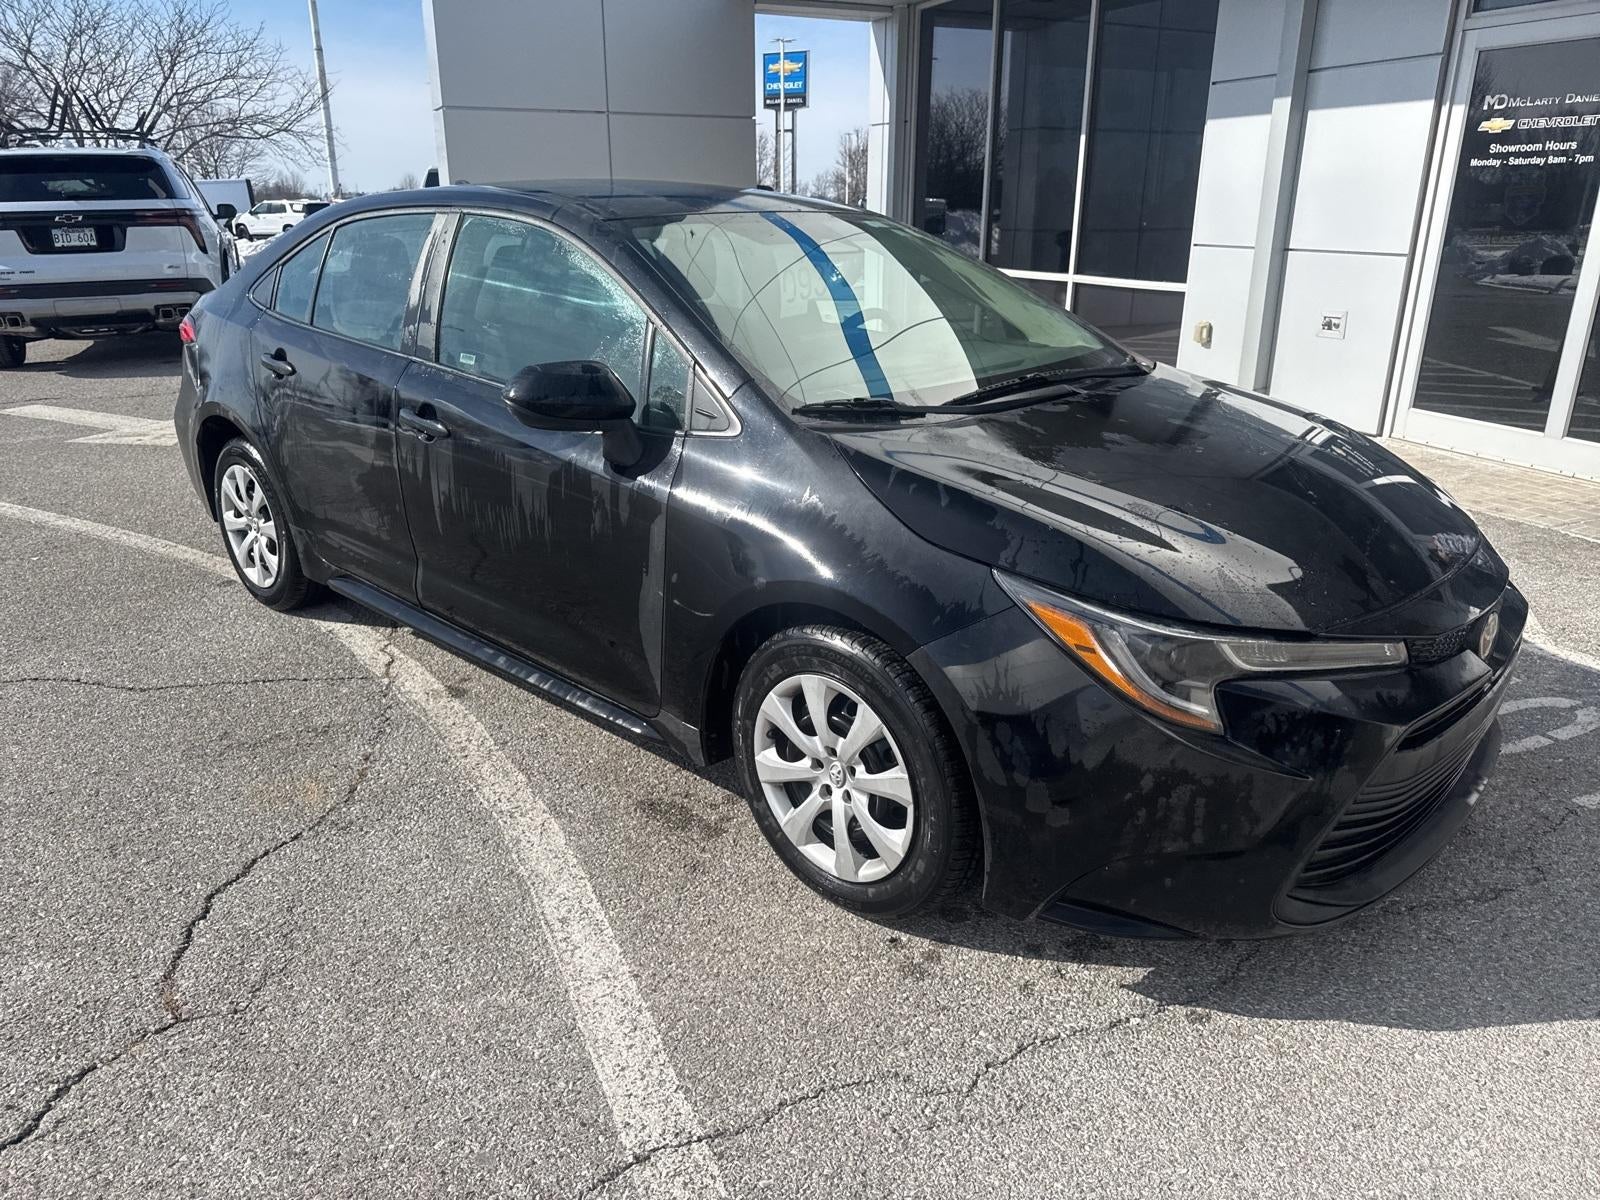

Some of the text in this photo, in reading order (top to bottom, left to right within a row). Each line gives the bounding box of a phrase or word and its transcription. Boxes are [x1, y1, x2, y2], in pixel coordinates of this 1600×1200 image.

[1565, 93, 1600, 104] DANIE
[1517, 114, 1600, 129] CHEVROLET
[1489, 140, 1578, 153] Showroom Hours
[1470, 158, 1502, 168] Monday
[1508, 155, 1546, 167] Saturday
[1547, 155, 1567, 164] 8am
[1574, 153, 1595, 164] 7pm
